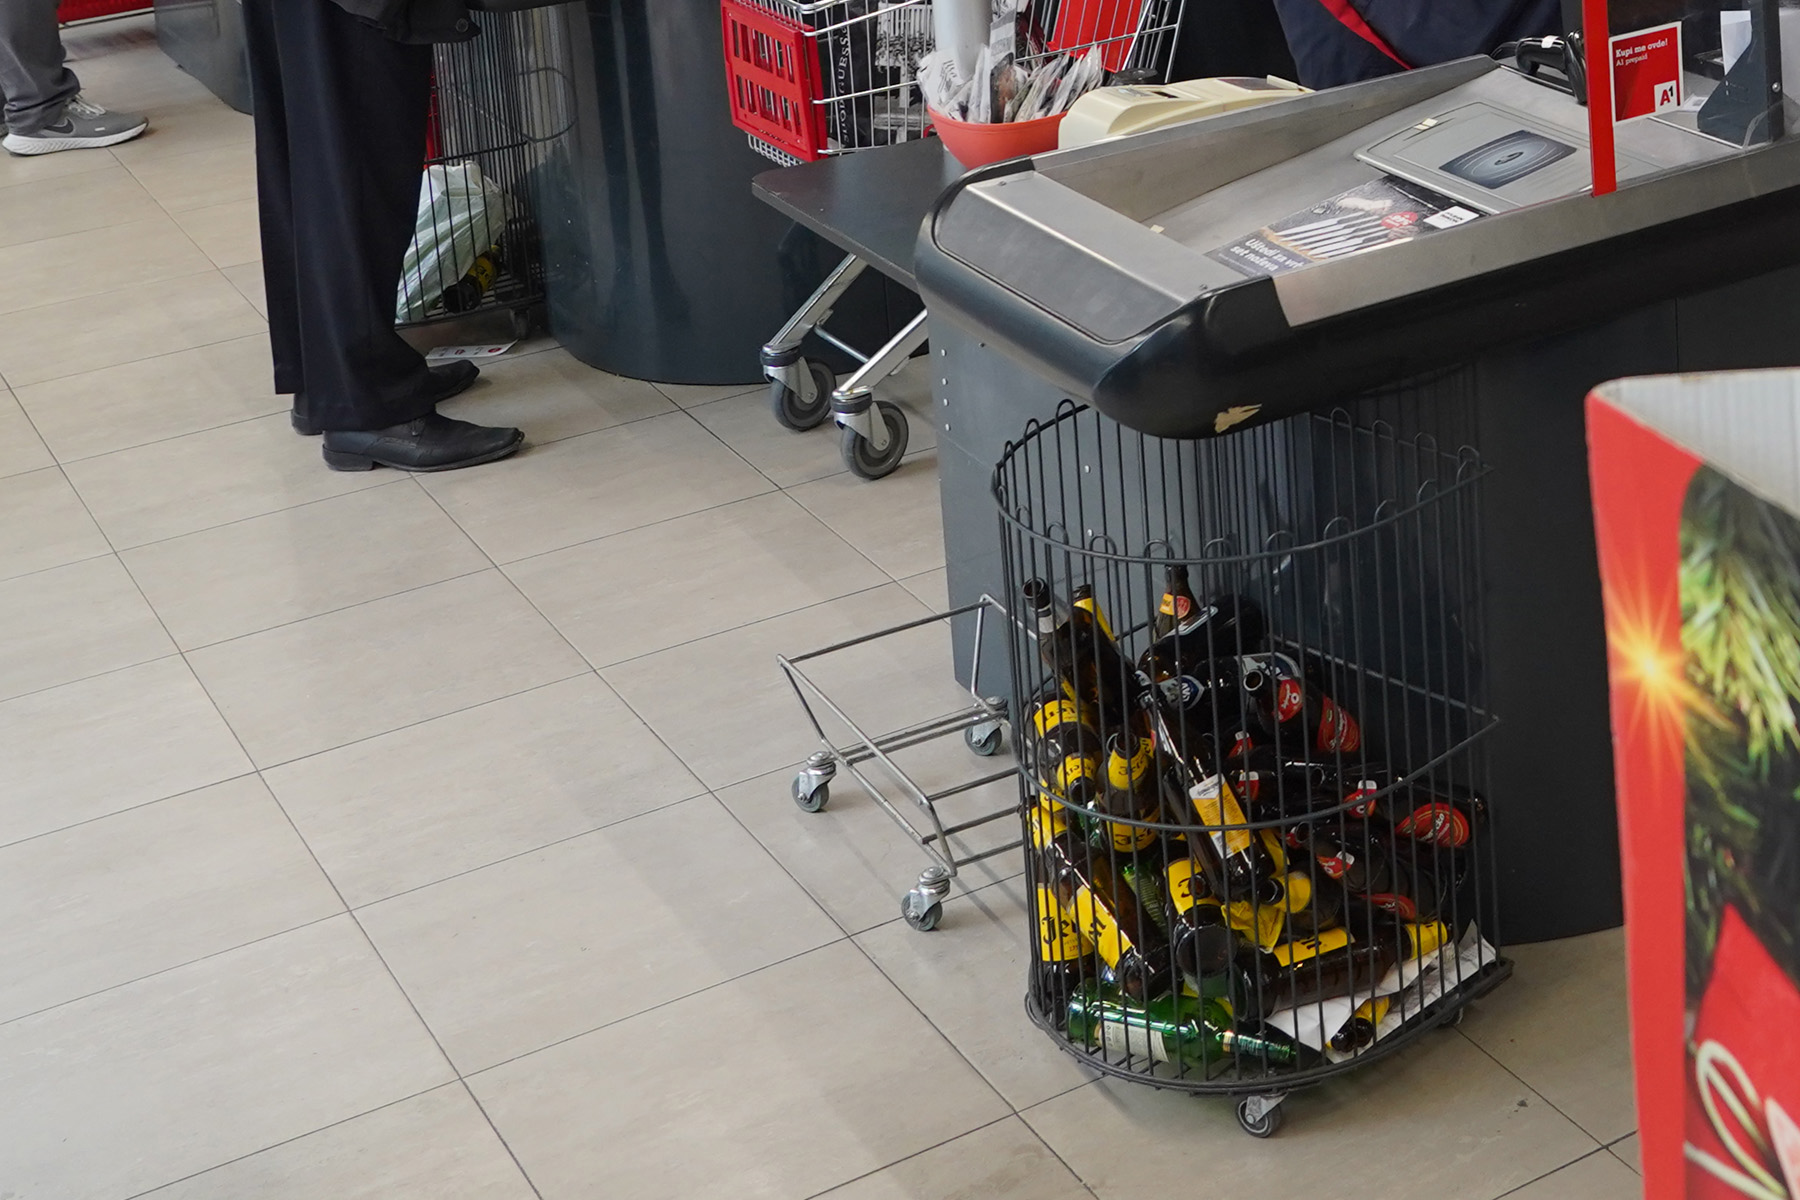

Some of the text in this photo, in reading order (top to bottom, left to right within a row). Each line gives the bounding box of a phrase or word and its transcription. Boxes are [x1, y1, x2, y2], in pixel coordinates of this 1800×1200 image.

[1615, 37, 1669, 58] Kupi me ovde!
[1625, 53, 1648, 66] prepaid
[1659, 84, 1674, 107] A1
[1230, 245, 1280, 273] set noževa
